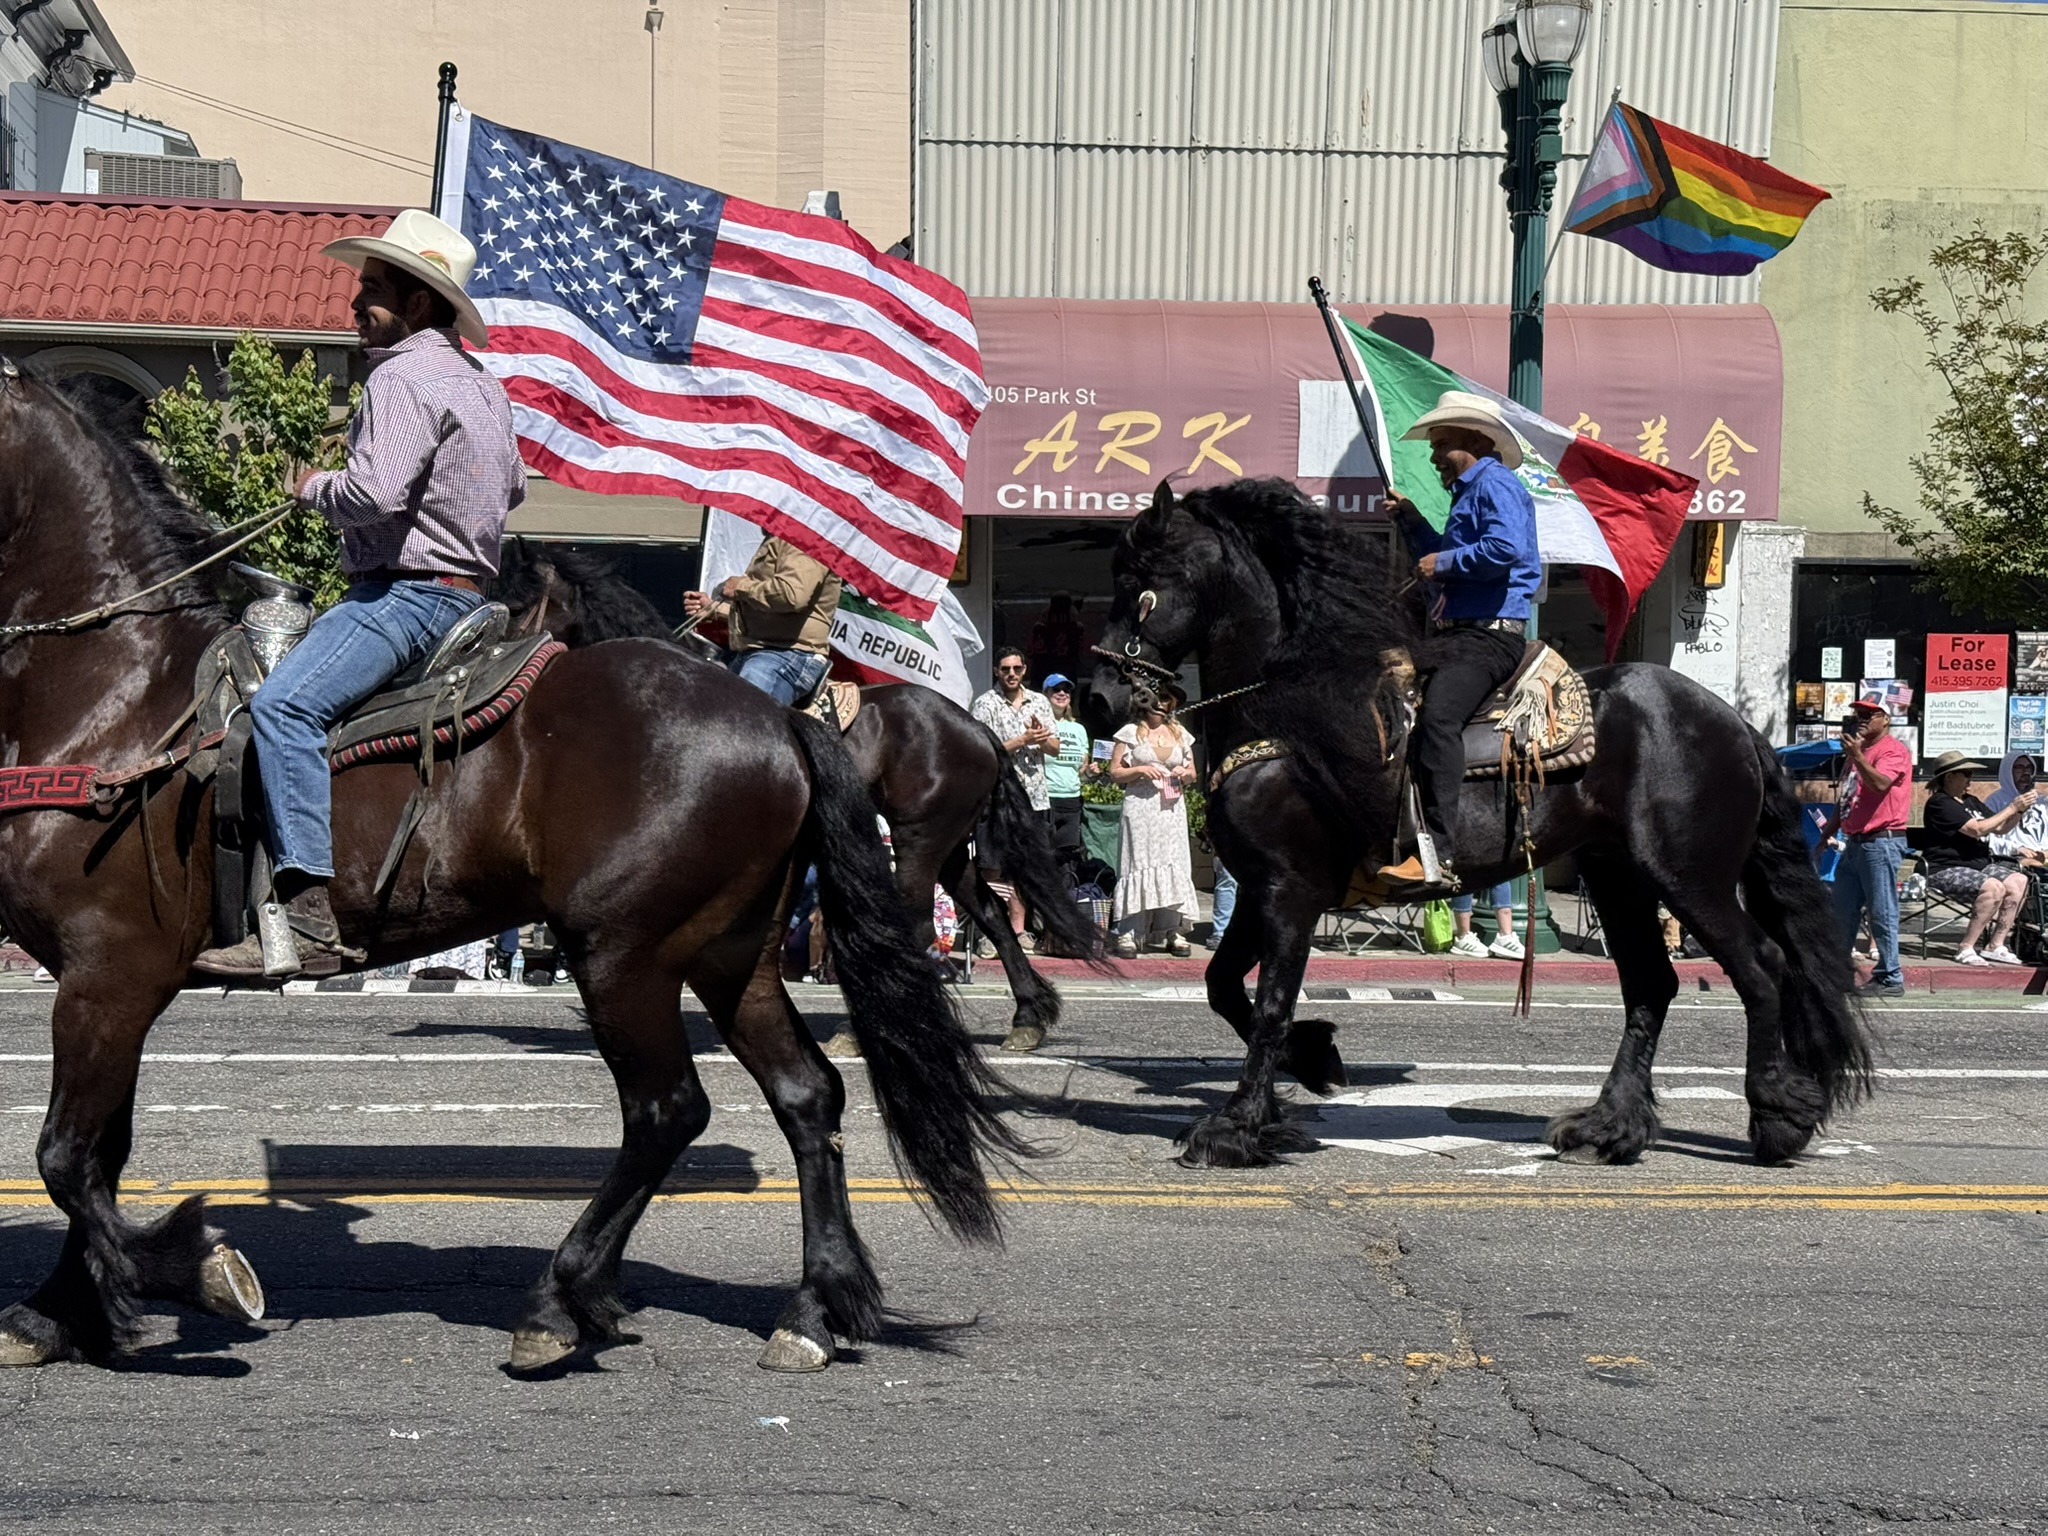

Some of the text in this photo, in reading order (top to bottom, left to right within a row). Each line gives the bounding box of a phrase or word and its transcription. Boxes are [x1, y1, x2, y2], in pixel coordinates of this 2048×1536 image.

[1025, 388, 1070, 404] Park
[1075, 388, 1096, 405] St
[1013, 410, 1252, 476] ARK
[996, 483, 1186, 511] Chines
[1951, 637, 1985, 653] For
[858, 631, 942, 681] REPUBLIC
[1938, 655, 1996, 671] Lease
[1930, 676, 2003, 687] 415.395.7262
[1929, 700, 1979, 708] Justin Choi
[1928, 721, 1995, 730] Jeff Badstubner
